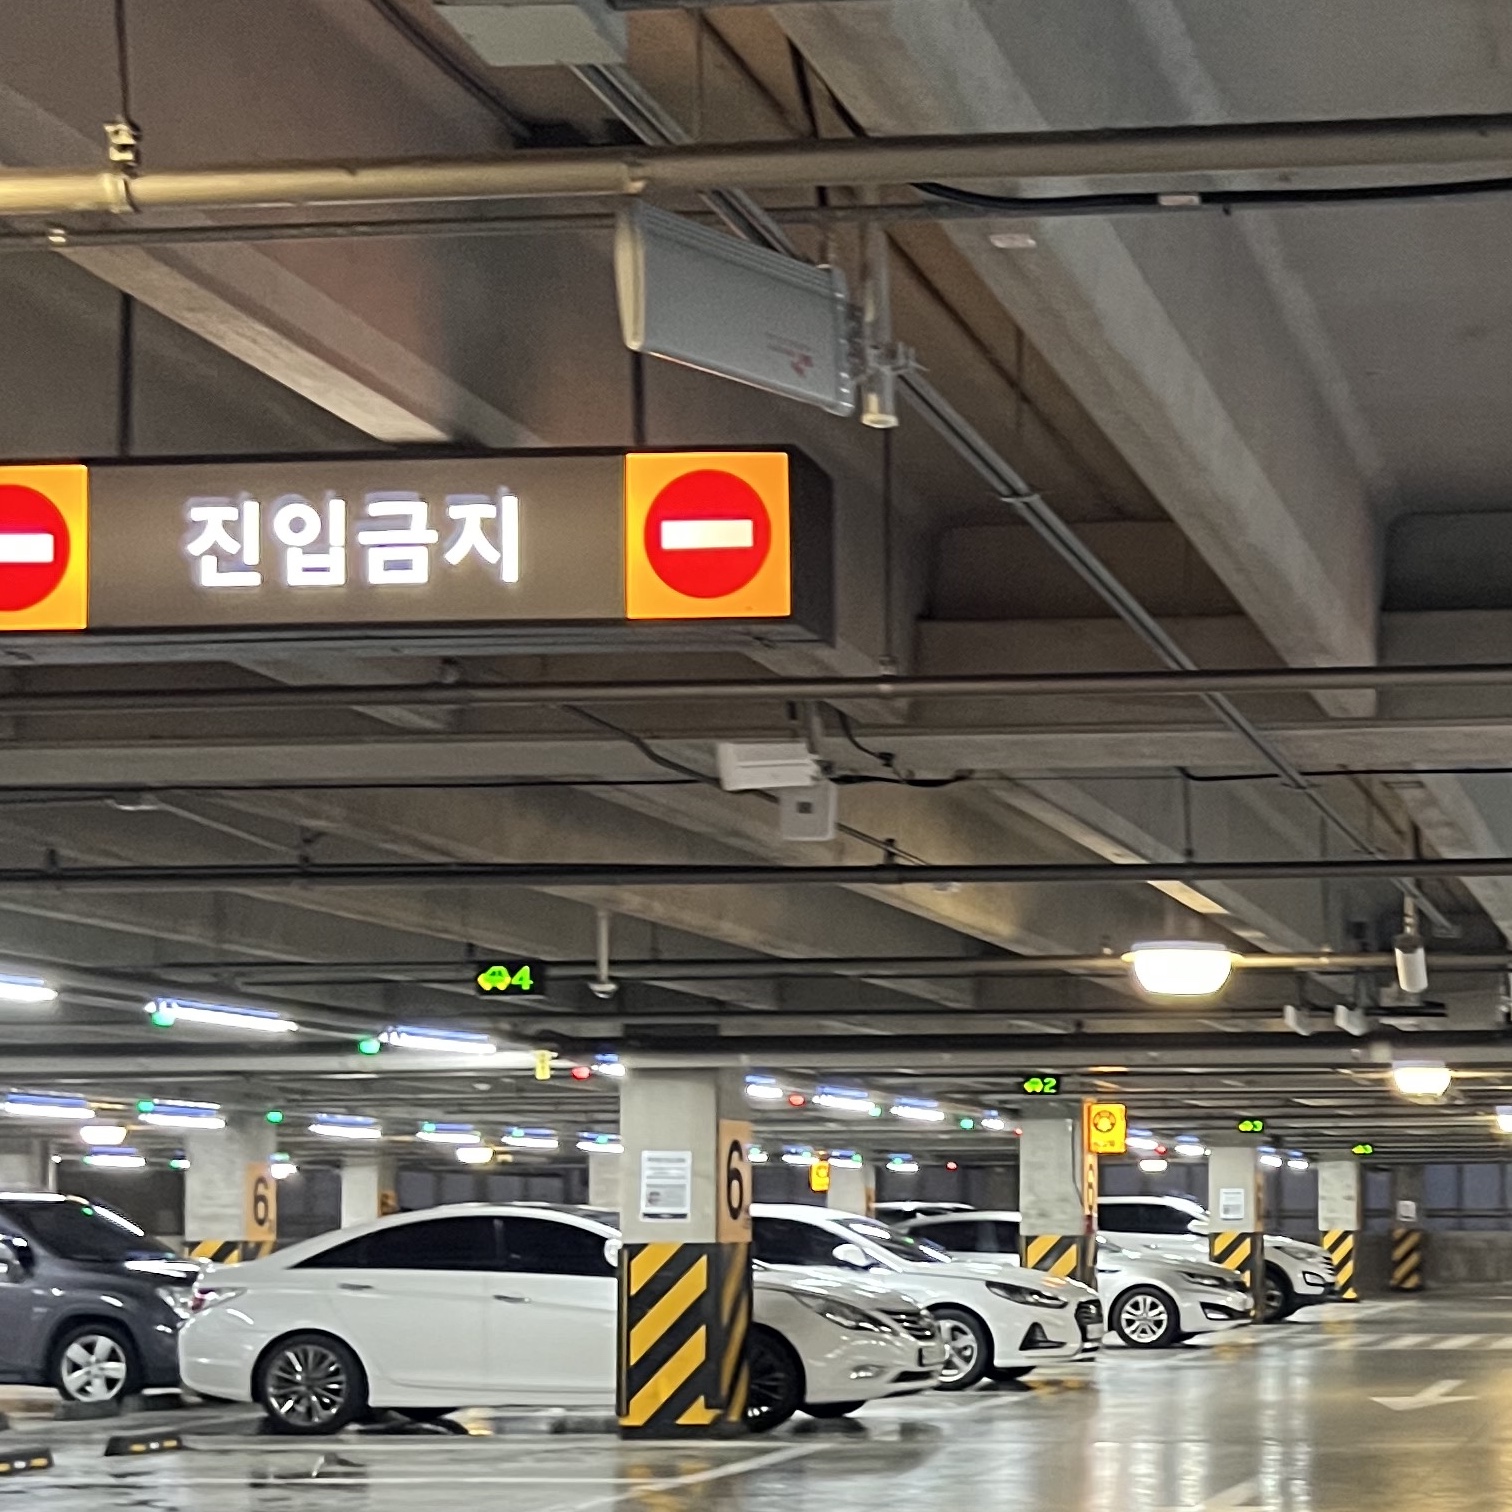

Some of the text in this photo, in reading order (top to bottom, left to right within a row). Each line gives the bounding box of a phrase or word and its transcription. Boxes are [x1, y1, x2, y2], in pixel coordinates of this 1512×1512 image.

[187, 492, 520, 588] 진입금지
[511, 965, 533, 990] 4
[1043, 1077, 1057, 1093] 2
